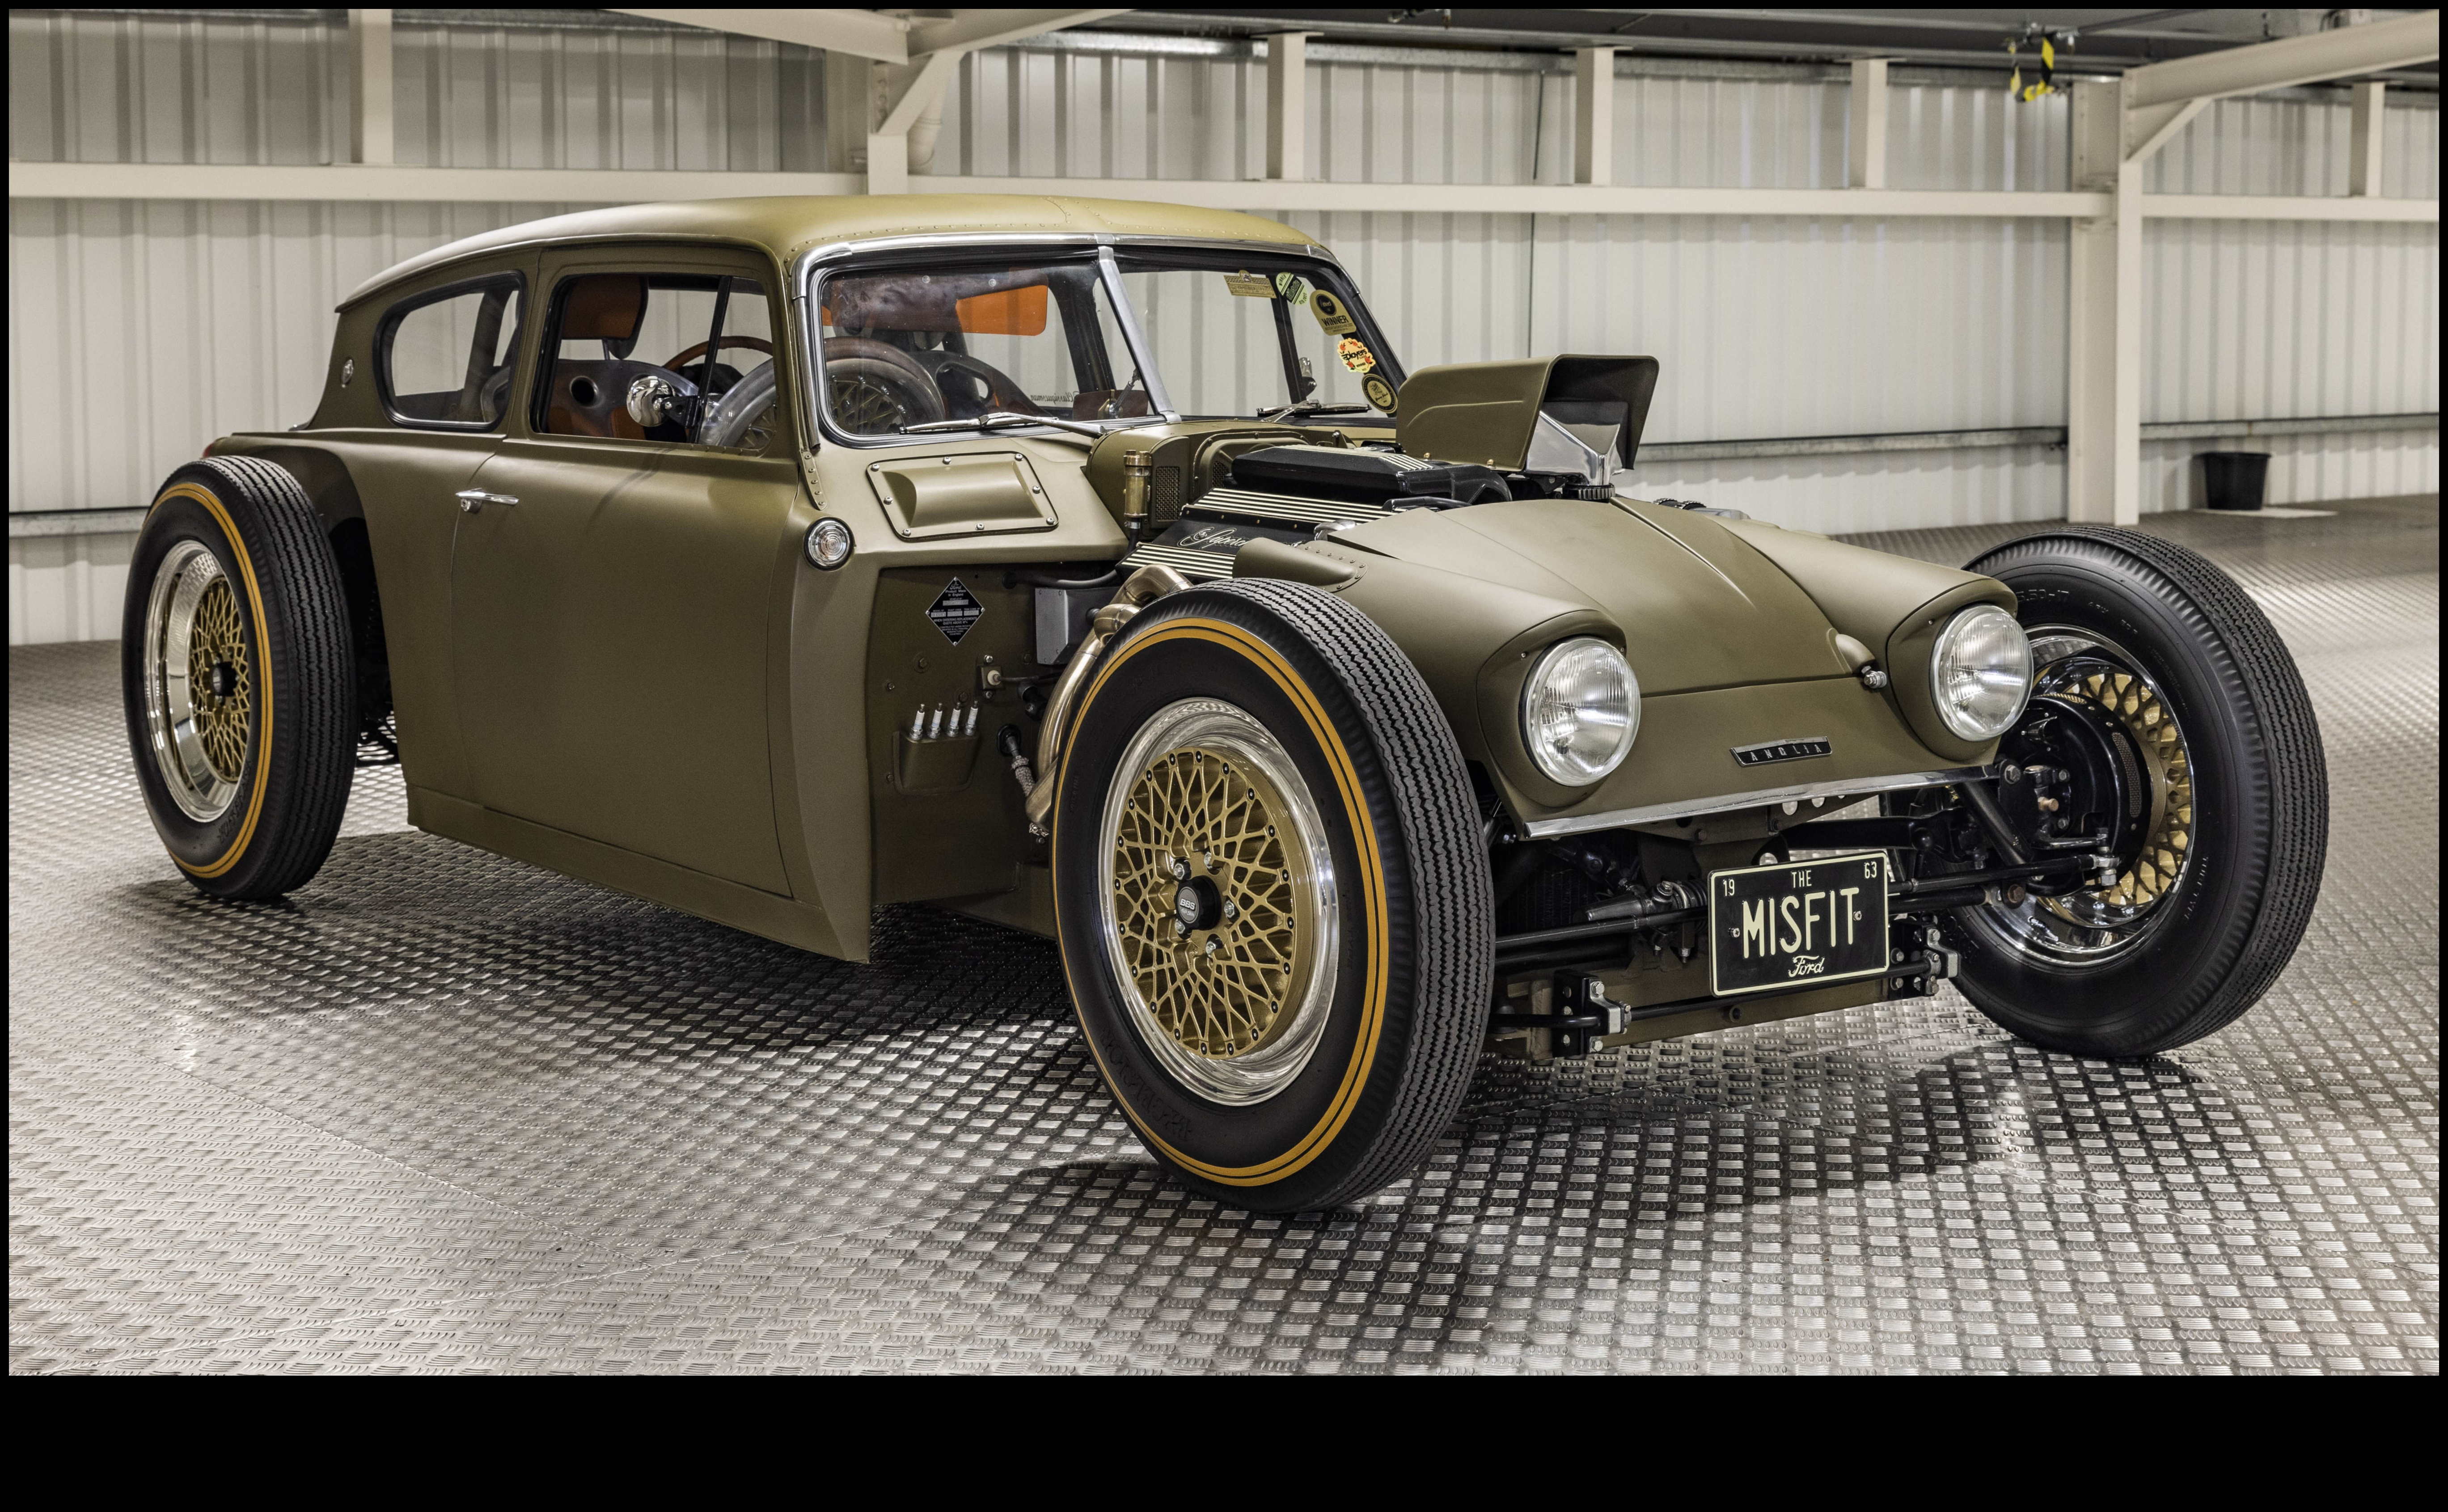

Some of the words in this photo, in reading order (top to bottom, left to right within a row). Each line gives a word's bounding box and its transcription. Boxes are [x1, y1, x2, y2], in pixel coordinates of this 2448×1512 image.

[1321, 315, 1349, 327] WINNER
[1343, 349, 1368, 360] players
[1750, 744, 1822, 761] ANGLIA
[1792, 870, 1812, 888] THE
[1864, 861, 1877, 879] 63
[1722, 879, 1735, 897] 19
[1180, 898, 1196, 911] BBS
[1742, 887, 1860, 959] MISFIT
[1788, 955, 1825, 978] Ford
